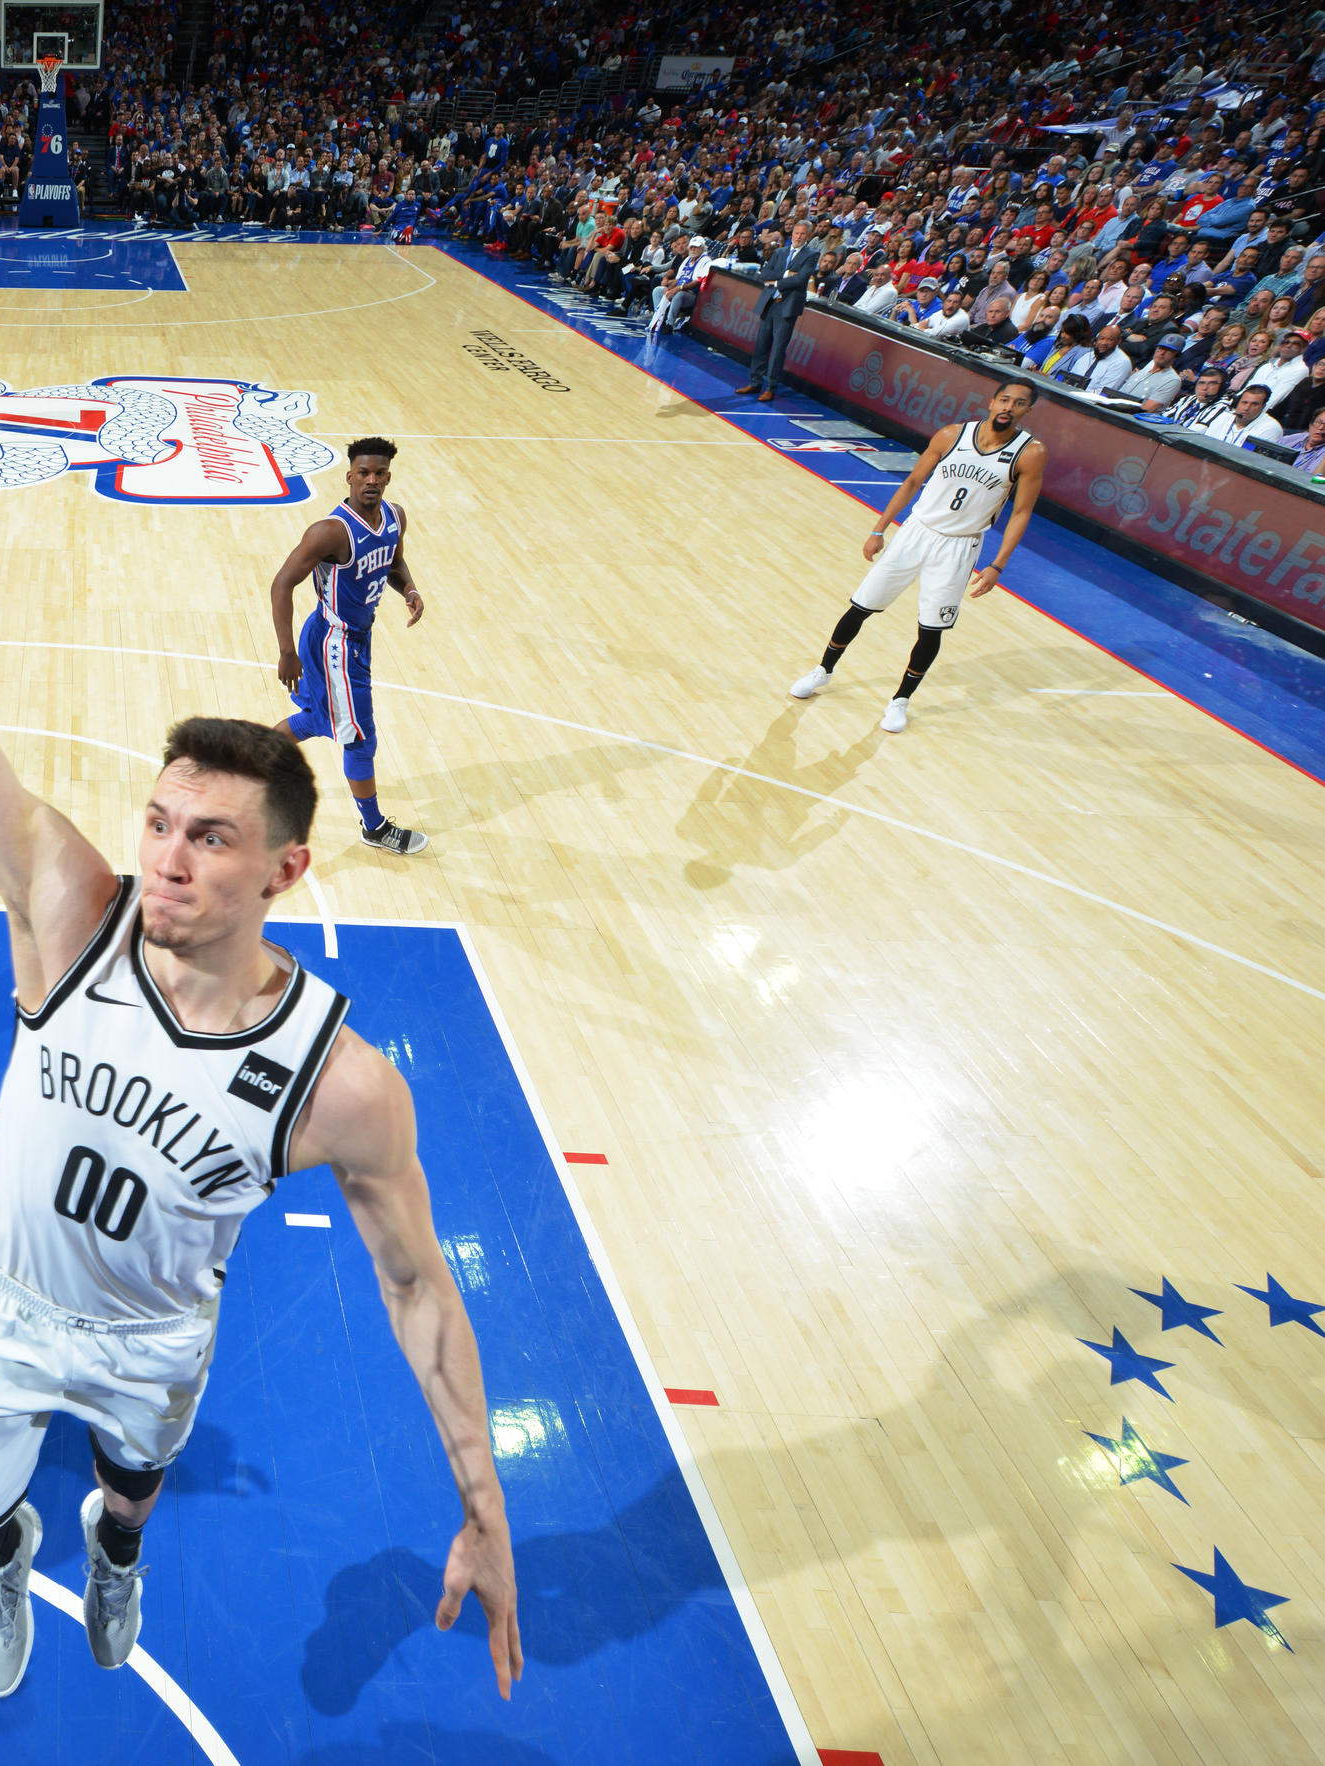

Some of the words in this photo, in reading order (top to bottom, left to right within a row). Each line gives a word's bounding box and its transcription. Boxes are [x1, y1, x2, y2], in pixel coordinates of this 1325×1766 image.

[40, 134, 63, 155] 76
[35, 184, 72, 200] PLAYOFFS
[506, 359, 571, 392] FARGO
[161, 387, 261, 484] Philadelphia
[942, 463, 1003, 491] BROOKLYN
[949, 487, 968, 511] 8
[355, 543, 397, 580] PHIL
[238, 1062, 282, 1096] infor
[39, 1044, 252, 1199] BROOKLYN
[54, 1145, 149, 1242] 00
